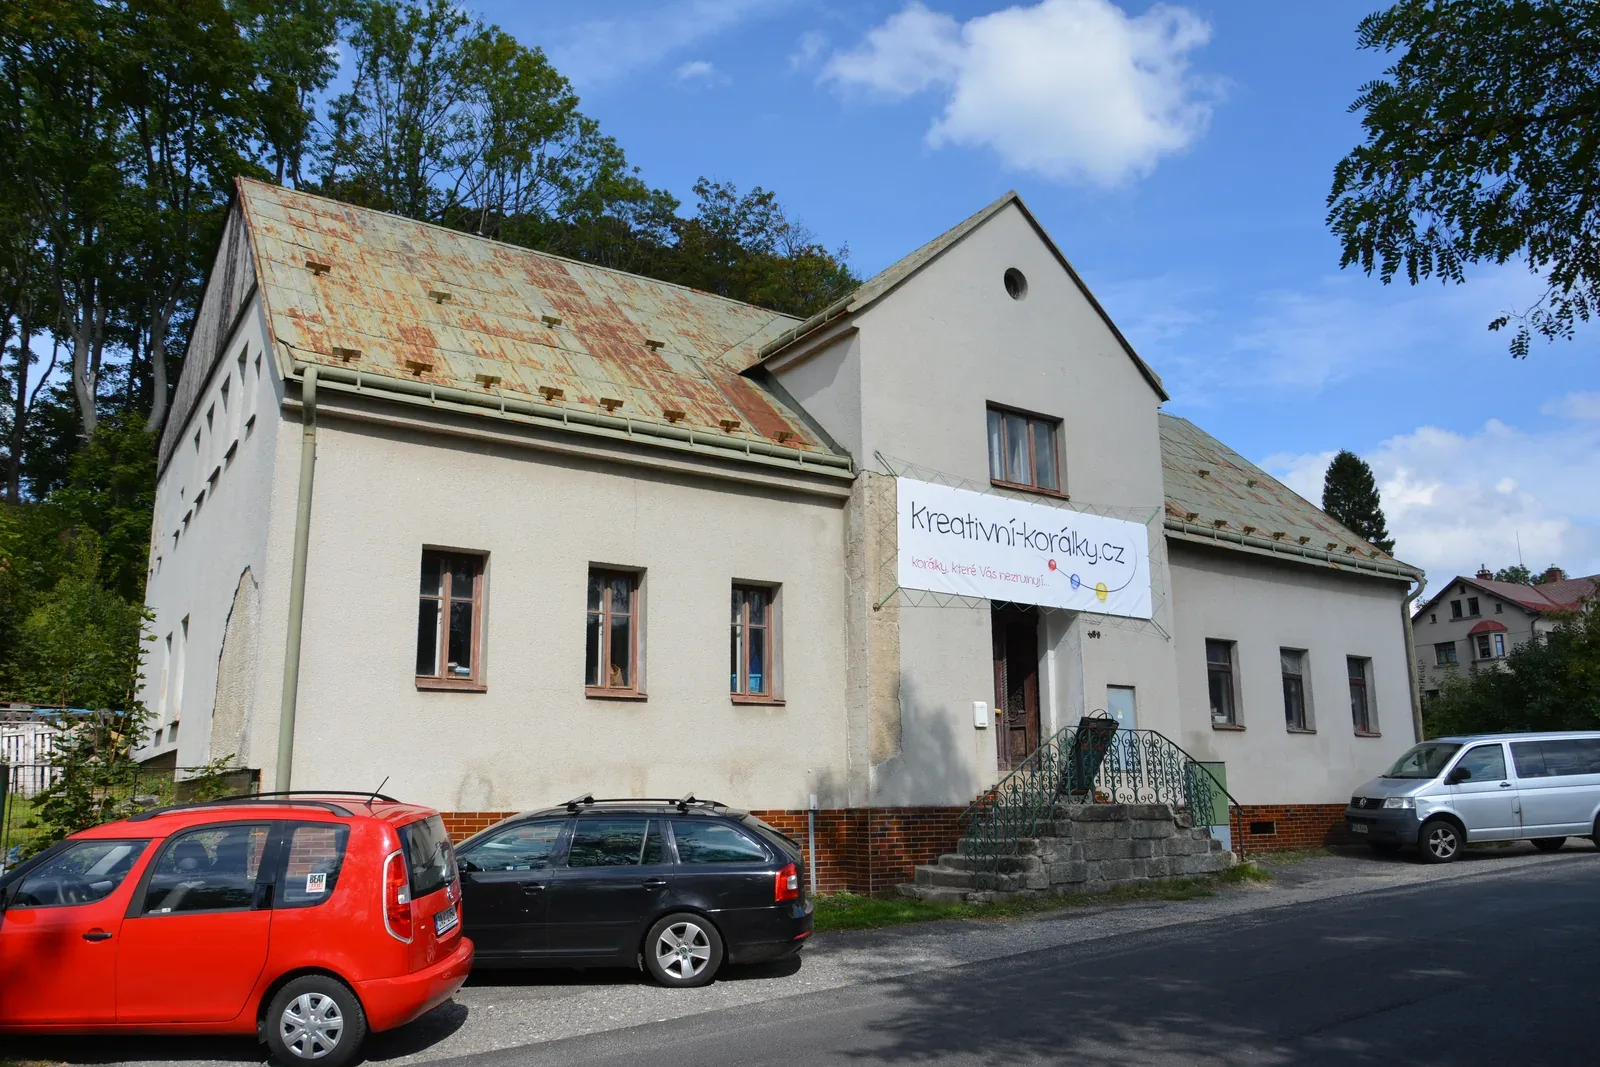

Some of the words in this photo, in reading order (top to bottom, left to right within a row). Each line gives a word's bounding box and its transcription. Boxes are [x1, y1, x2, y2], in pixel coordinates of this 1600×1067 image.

[951, 561, 977, 576] které
[979, 565, 997, 580] Vás
[309, 874, 325, 883] BEAT
